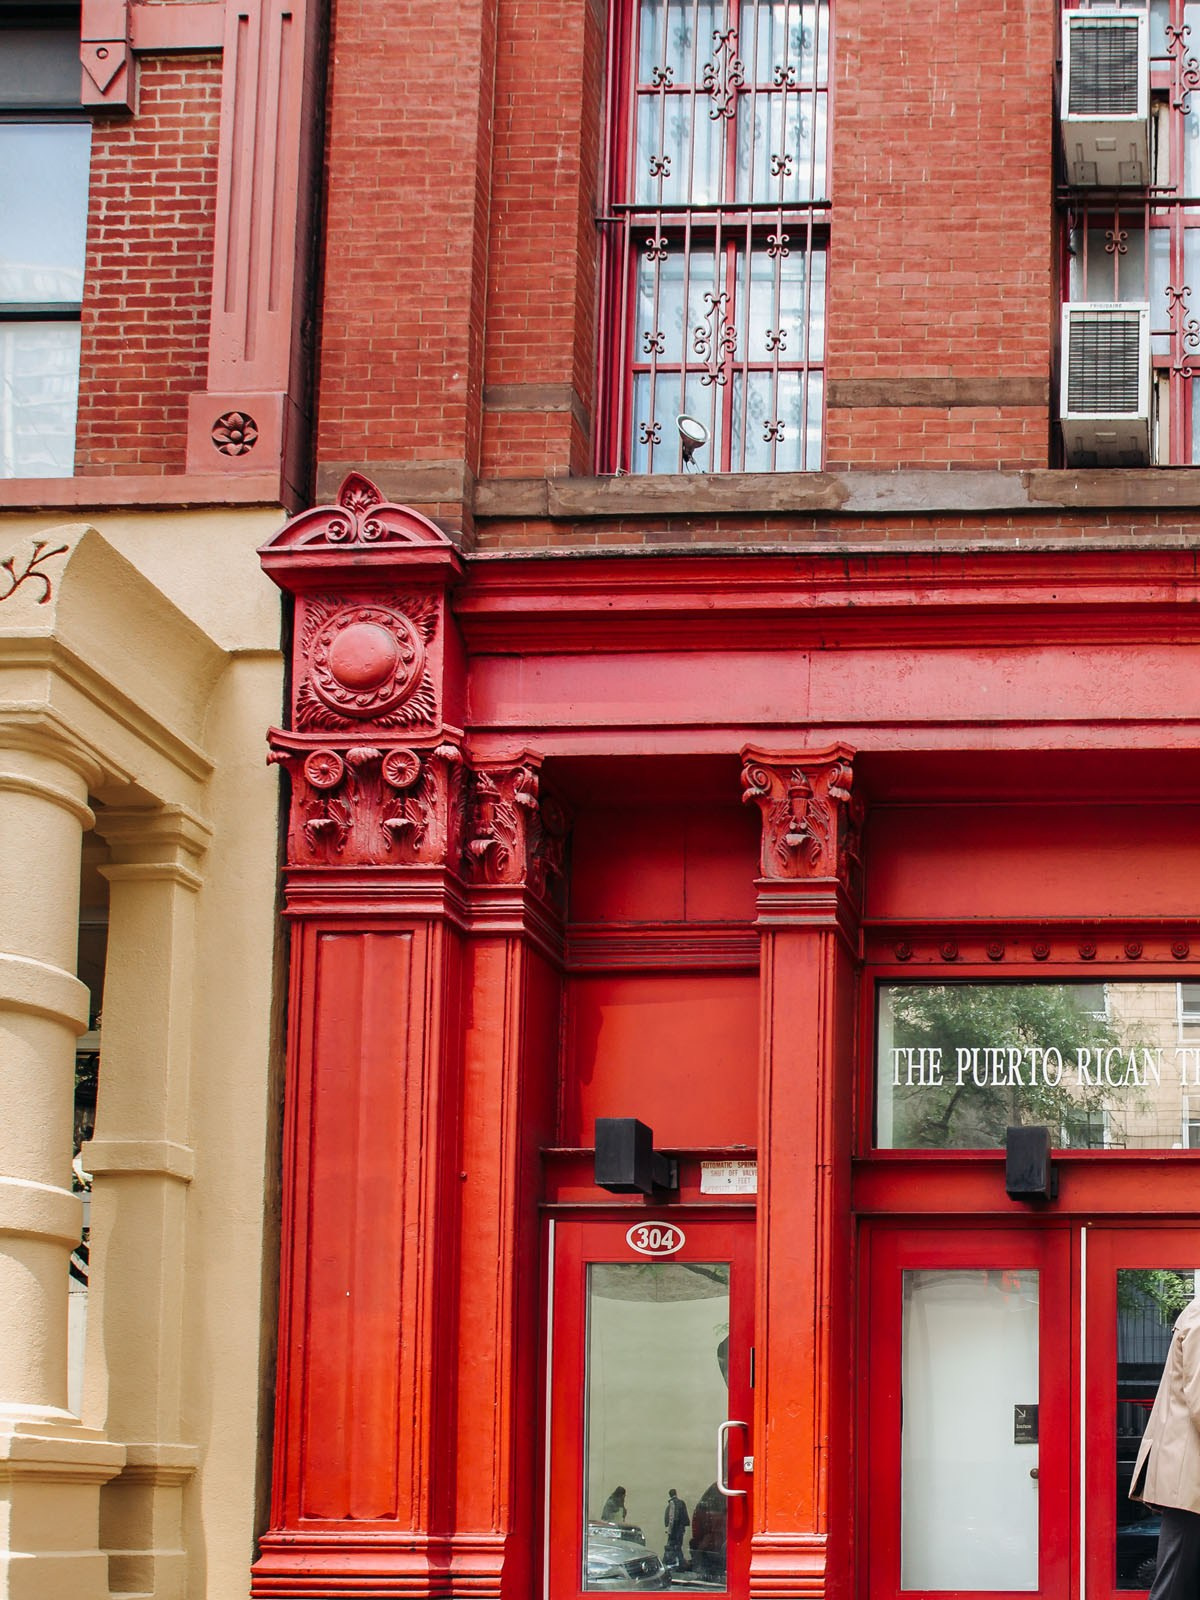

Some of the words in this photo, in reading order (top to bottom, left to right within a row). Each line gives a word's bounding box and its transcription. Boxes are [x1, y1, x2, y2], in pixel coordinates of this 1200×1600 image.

[891, 1047, 943, 1086] THE
[955, 1046, 1063, 1087] PUERTO
[1076, 1047, 1162, 1087] RICAN
[637, 1228, 673, 1249] 304
